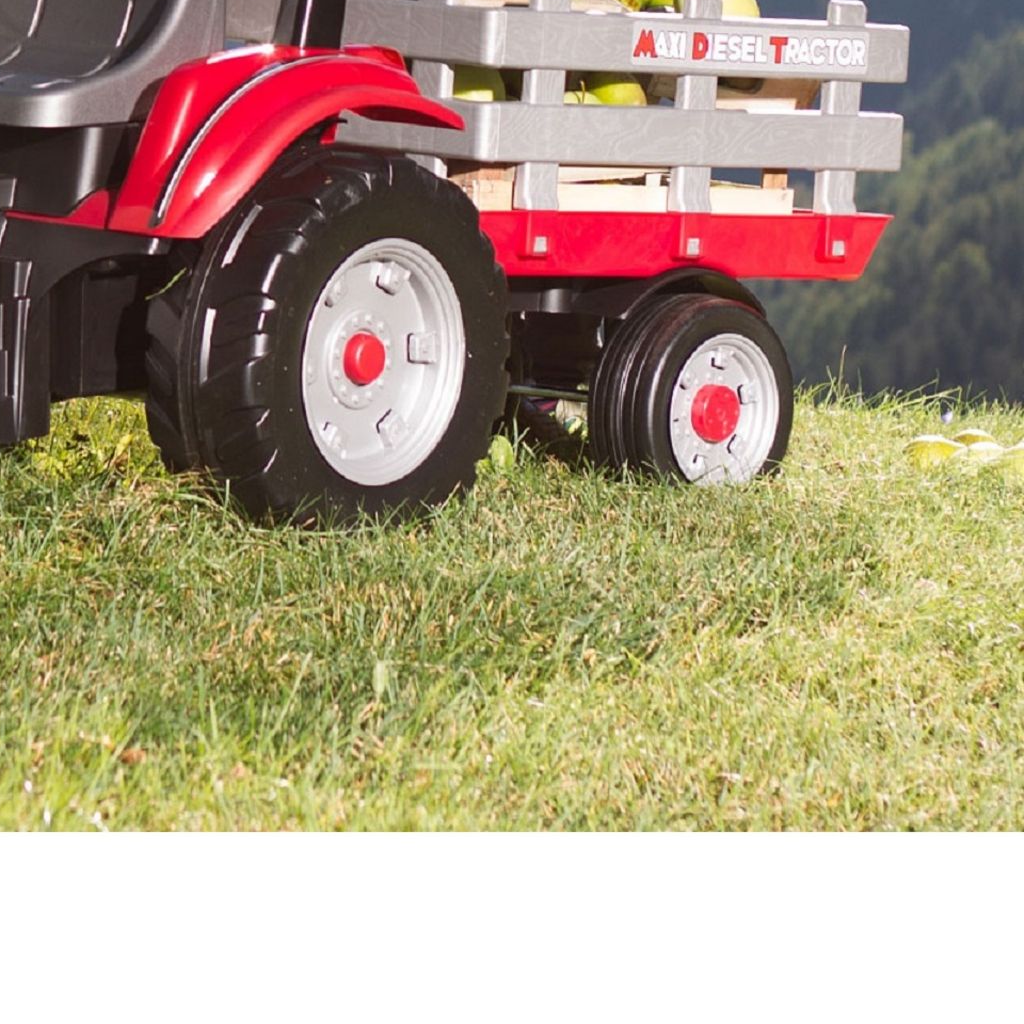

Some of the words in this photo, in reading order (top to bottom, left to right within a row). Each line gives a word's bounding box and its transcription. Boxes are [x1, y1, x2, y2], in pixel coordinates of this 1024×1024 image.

[633, 29, 686, 59] MAXI
[692, 32, 768, 64] DIESEL
[770, 36, 865, 66] TRACTOR
